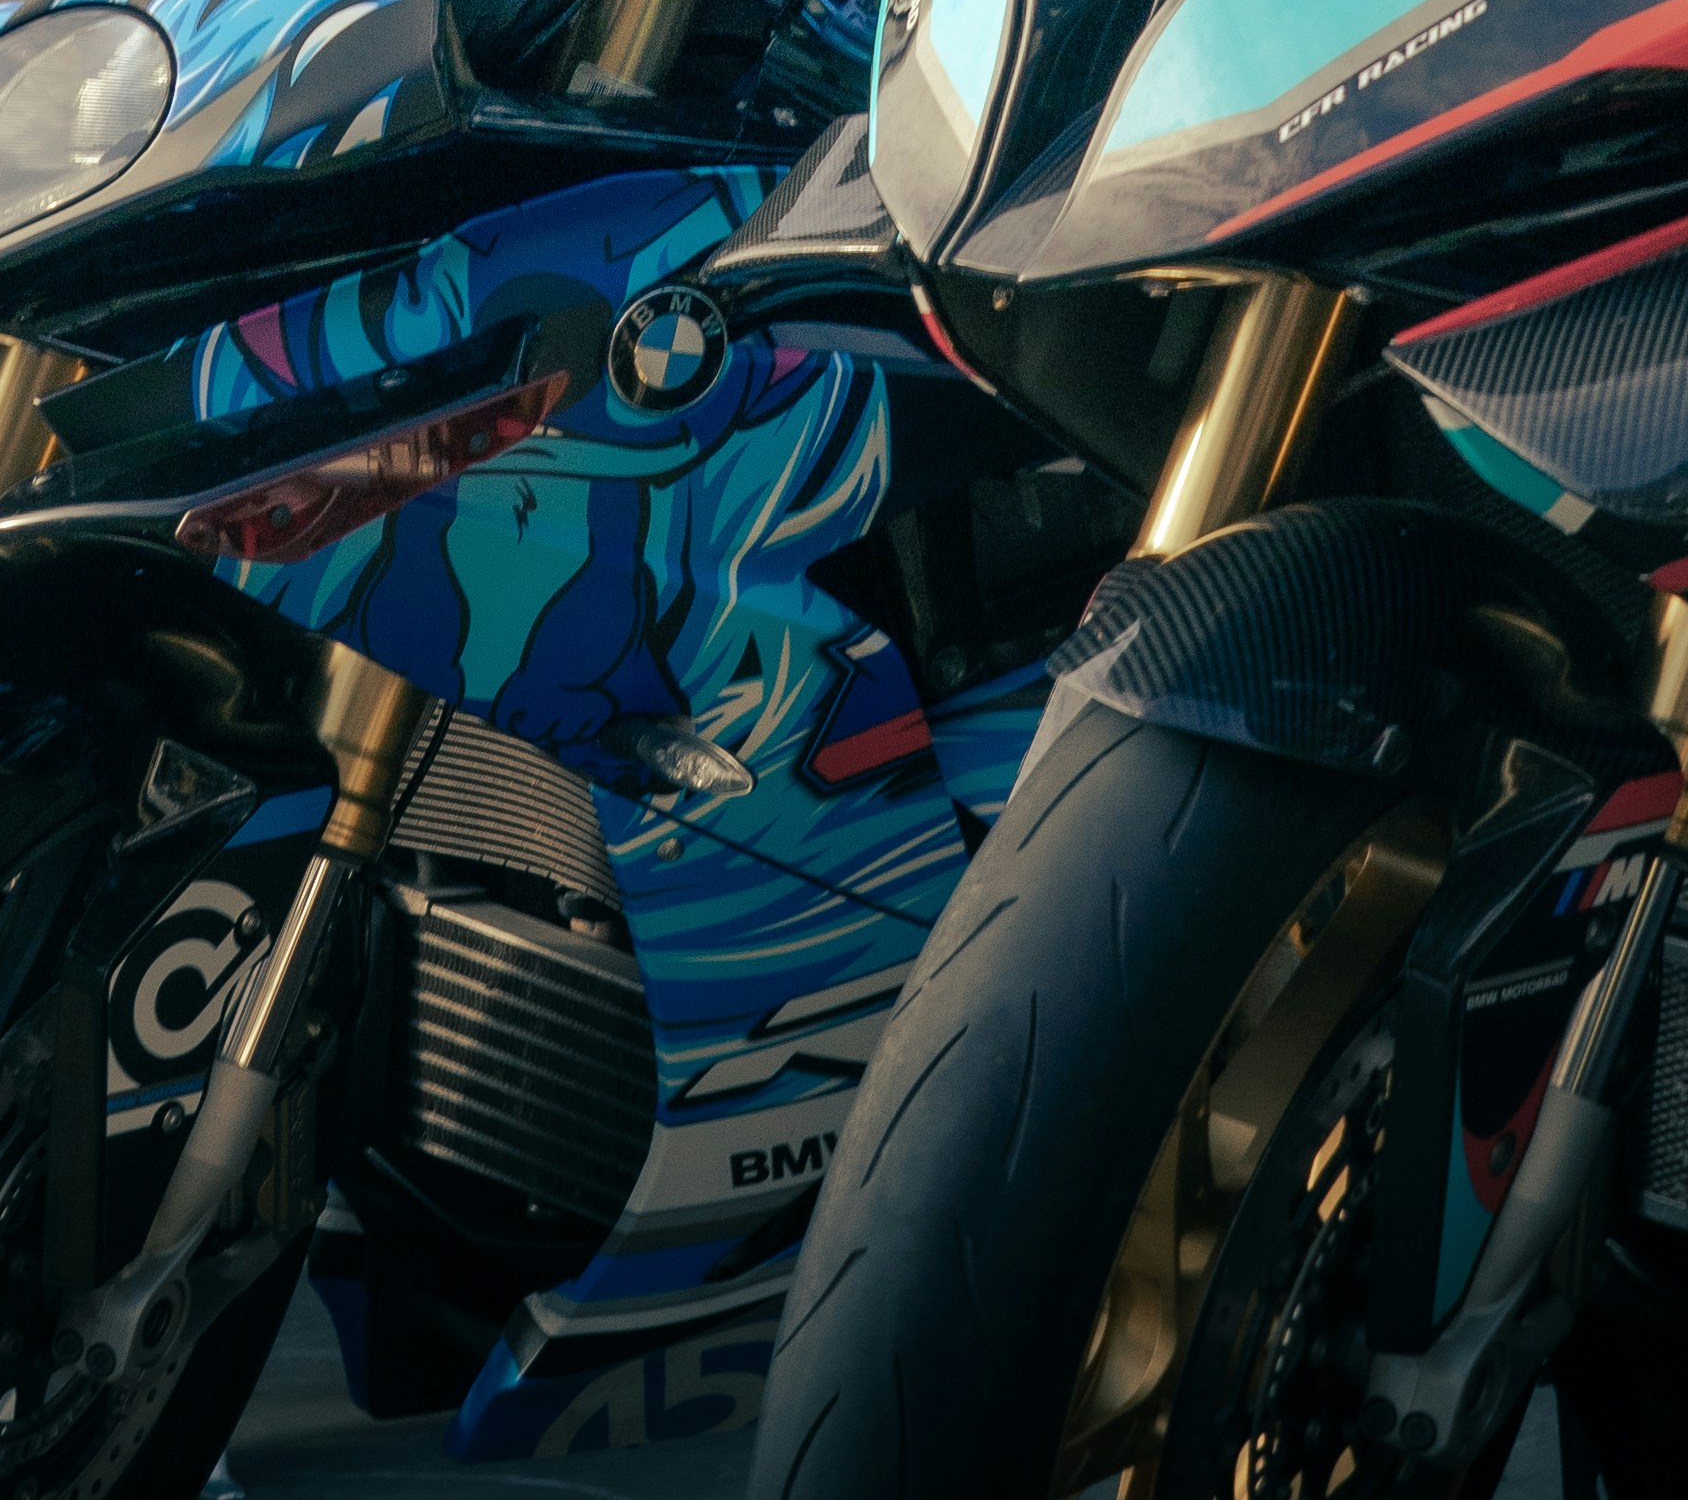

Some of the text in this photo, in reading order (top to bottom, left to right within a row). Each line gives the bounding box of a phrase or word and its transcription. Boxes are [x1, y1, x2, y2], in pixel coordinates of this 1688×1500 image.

[1277, 84, 1346, 144] CFR
[631, 292, 723, 338] BMW
[1592, 851, 1647, 909] M
